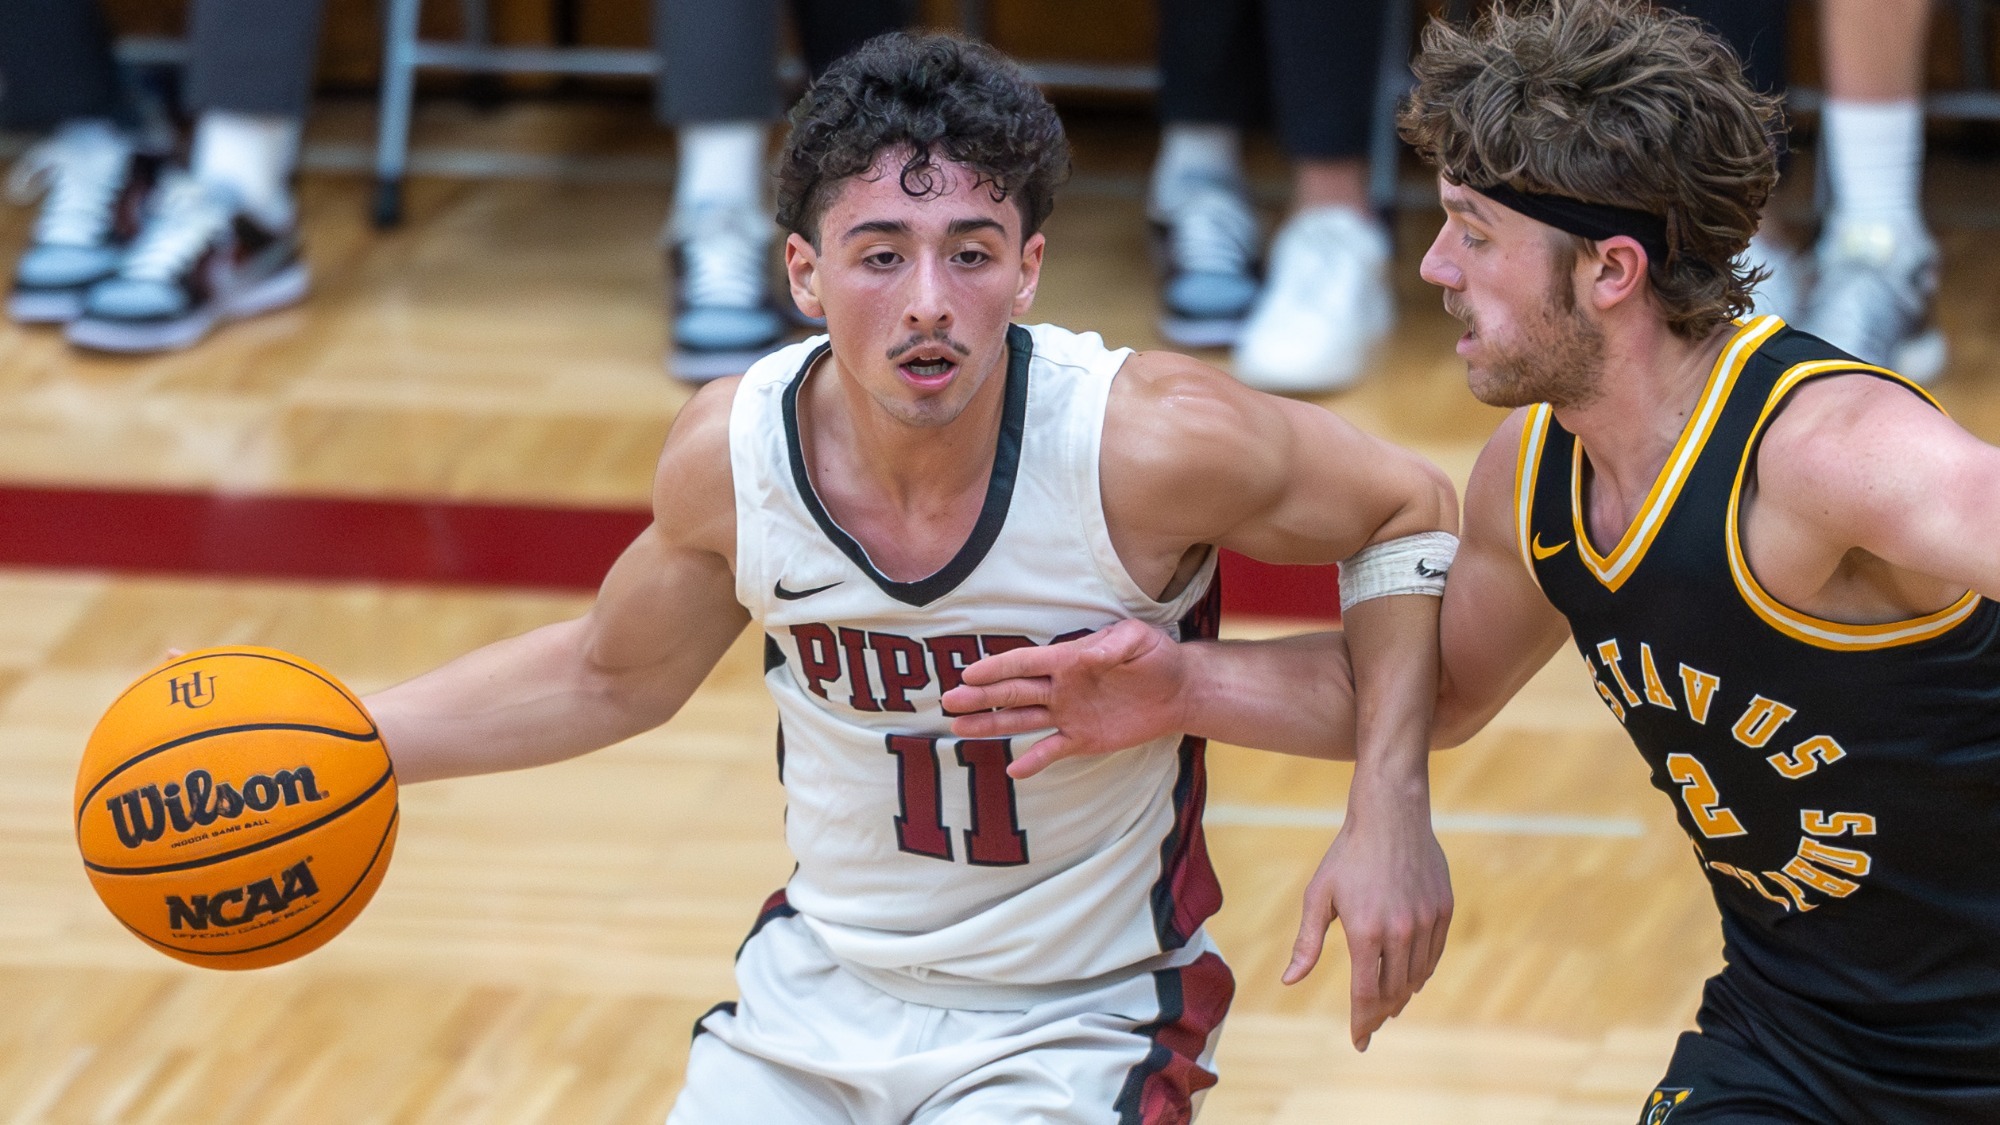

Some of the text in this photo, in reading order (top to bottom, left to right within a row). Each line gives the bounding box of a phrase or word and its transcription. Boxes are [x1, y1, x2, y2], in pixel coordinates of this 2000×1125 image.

[106, 766, 324, 849] Wilson
[171, 818, 270, 848] INDOOR GAME BALL
[885, 734, 1030, 867] 11
[1666, 753, 1748, 838] 2
[165, 860, 319, 931] NCAA
